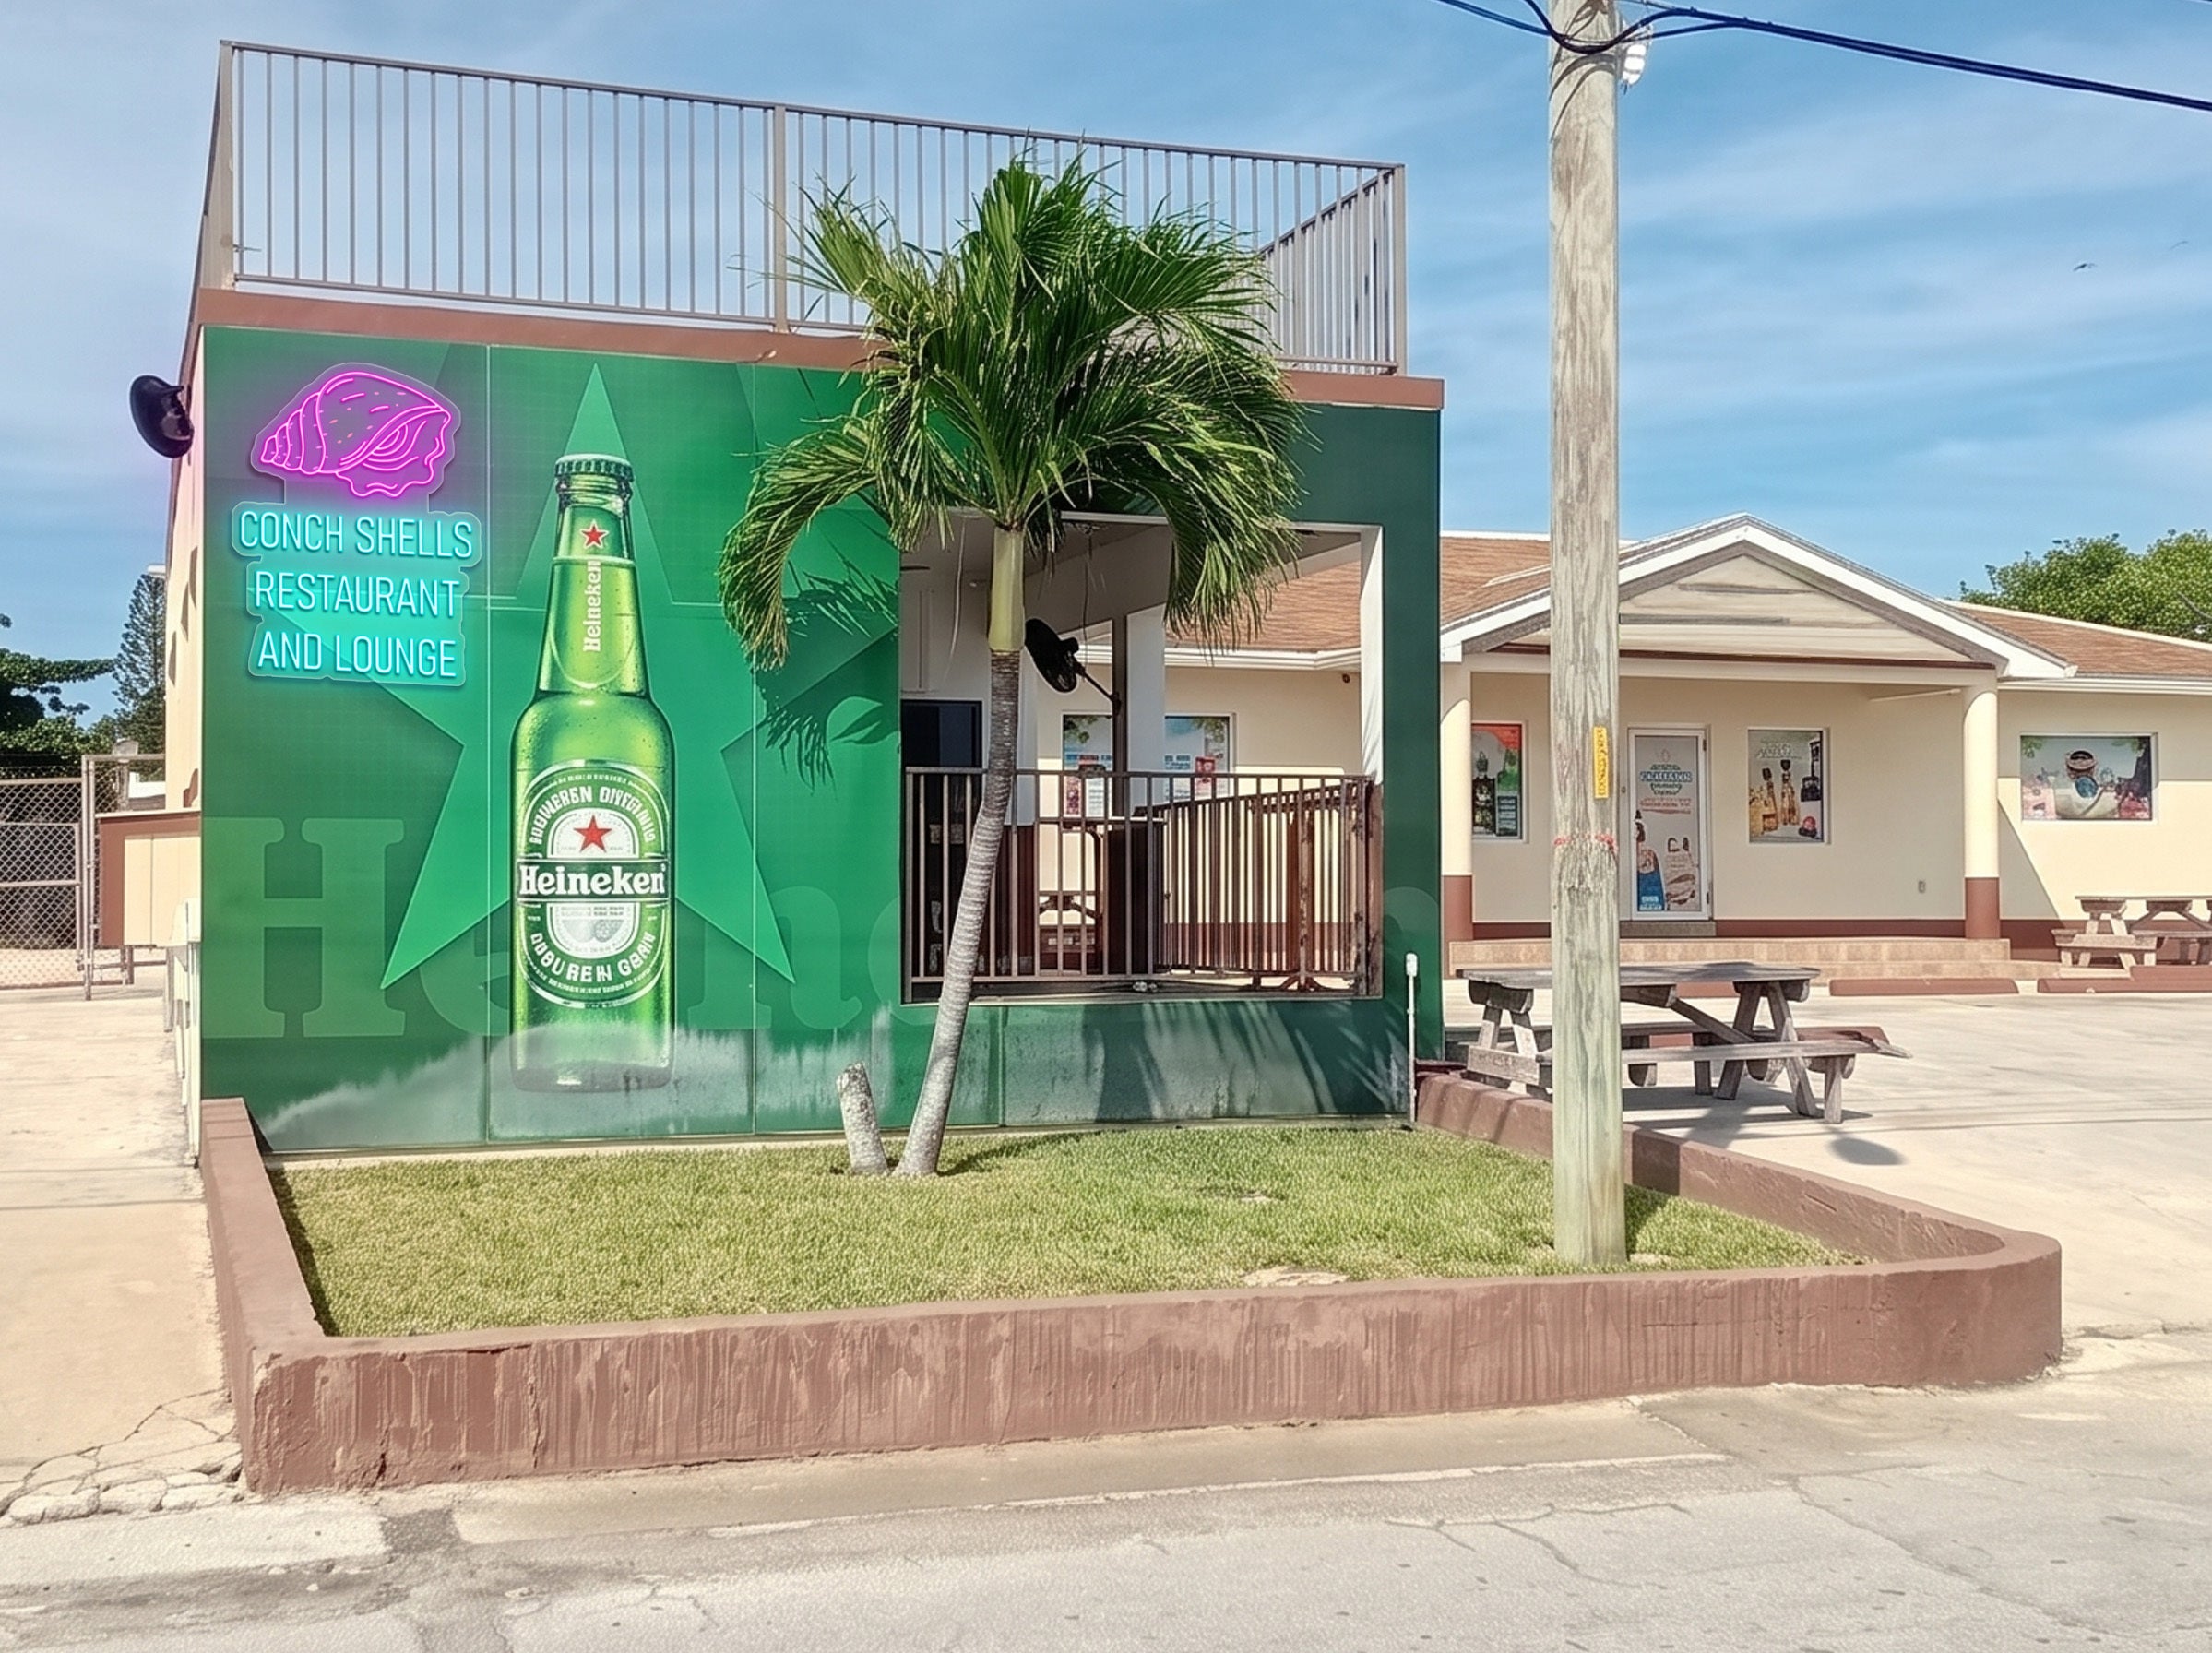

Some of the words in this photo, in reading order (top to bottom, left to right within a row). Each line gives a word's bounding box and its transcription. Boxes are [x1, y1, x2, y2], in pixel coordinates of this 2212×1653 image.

[240, 510, 344, 552] CONCH
[355, 517, 472, 559] SHELLS
[255, 570, 460, 617] RESTAURANT
[582, 559, 601, 652] Heineken
[257, 630, 322, 670] AND
[335, 634, 457, 677] LOUNGE
[519, 864, 666, 896] Heineken
